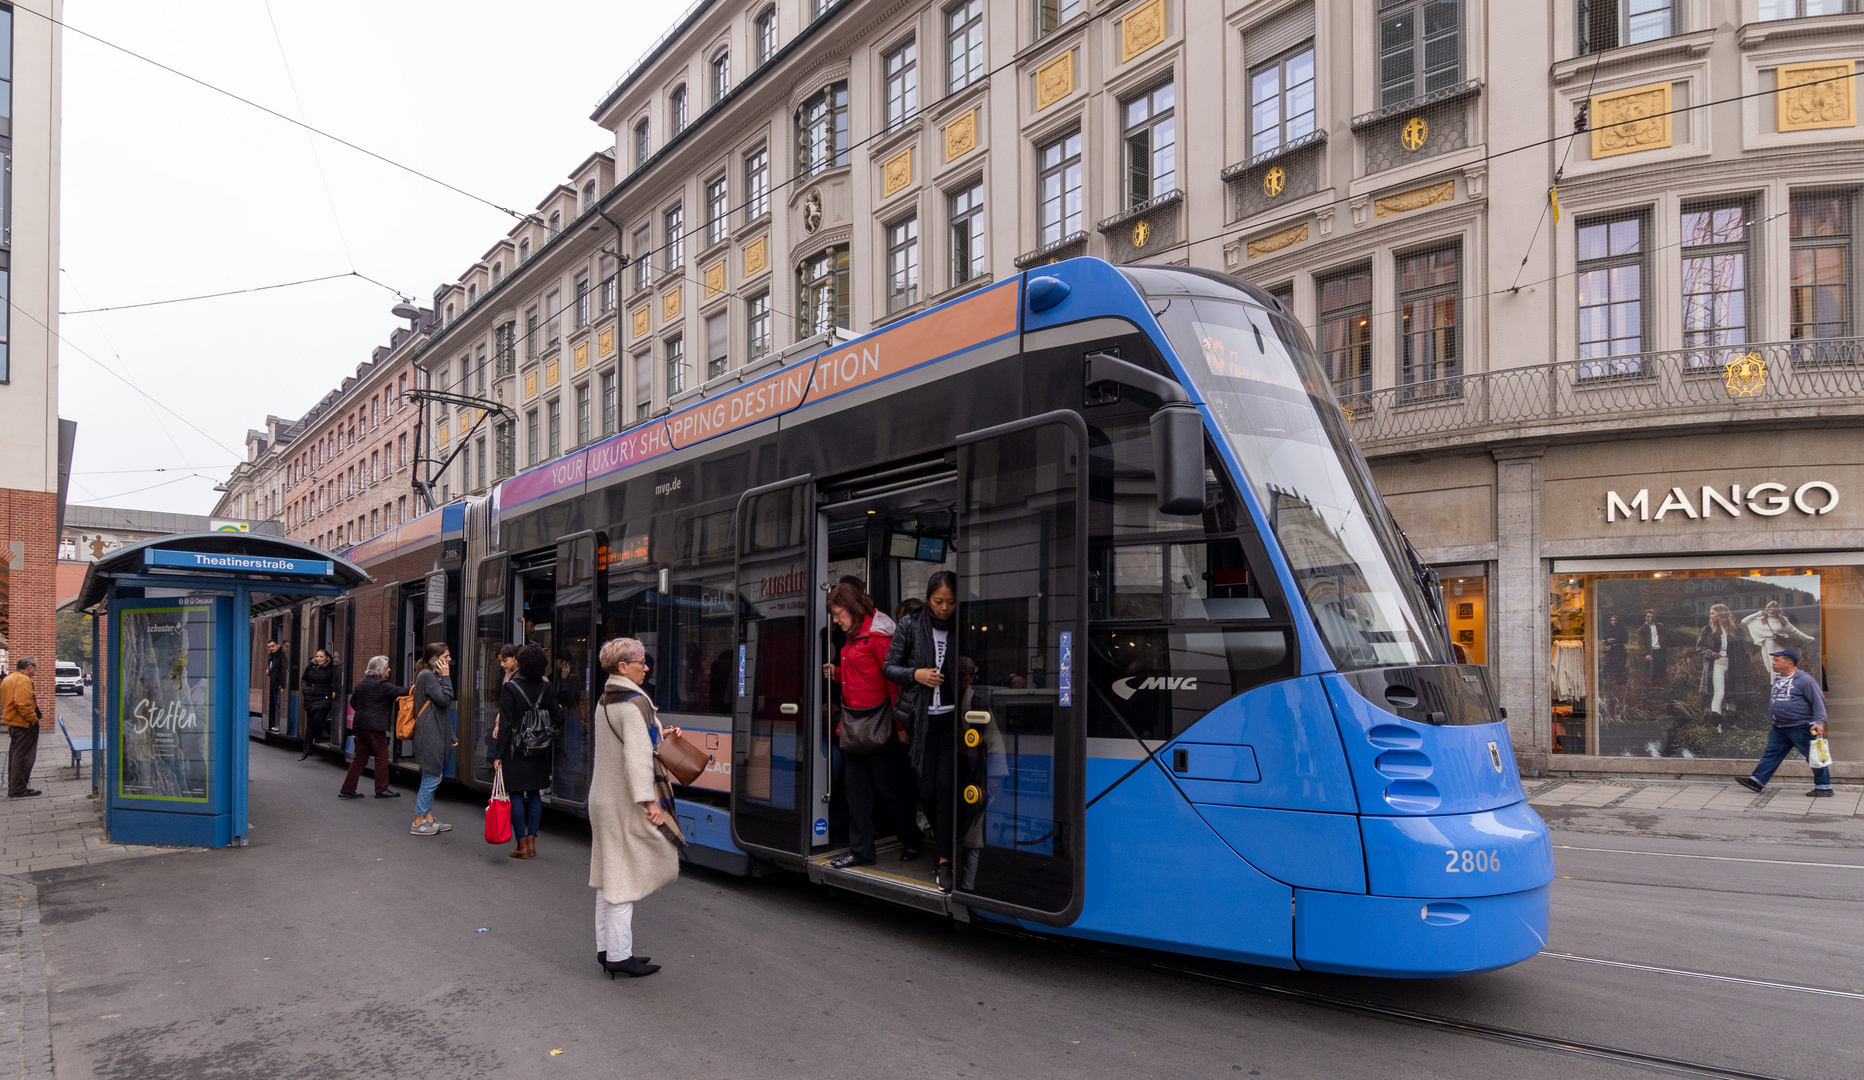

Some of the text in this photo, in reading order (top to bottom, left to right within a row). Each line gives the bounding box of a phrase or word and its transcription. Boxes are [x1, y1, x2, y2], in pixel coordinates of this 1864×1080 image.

[551, 343, 881, 486] YOUR LUXURY SHOPPING DESTINATION
[655, 476, 682, 496] mvg.de
[1606, 480, 1840, 523] MANGO
[194, 554, 294, 570] Theatinerstraße
[445, 548, 458, 559] 2806
[146, 623, 175, 633] schuster
[1137, 676, 1198, 690] MVG
[133, 698, 198, 734] Steffen
[1445, 848, 1501, 873] 2806
